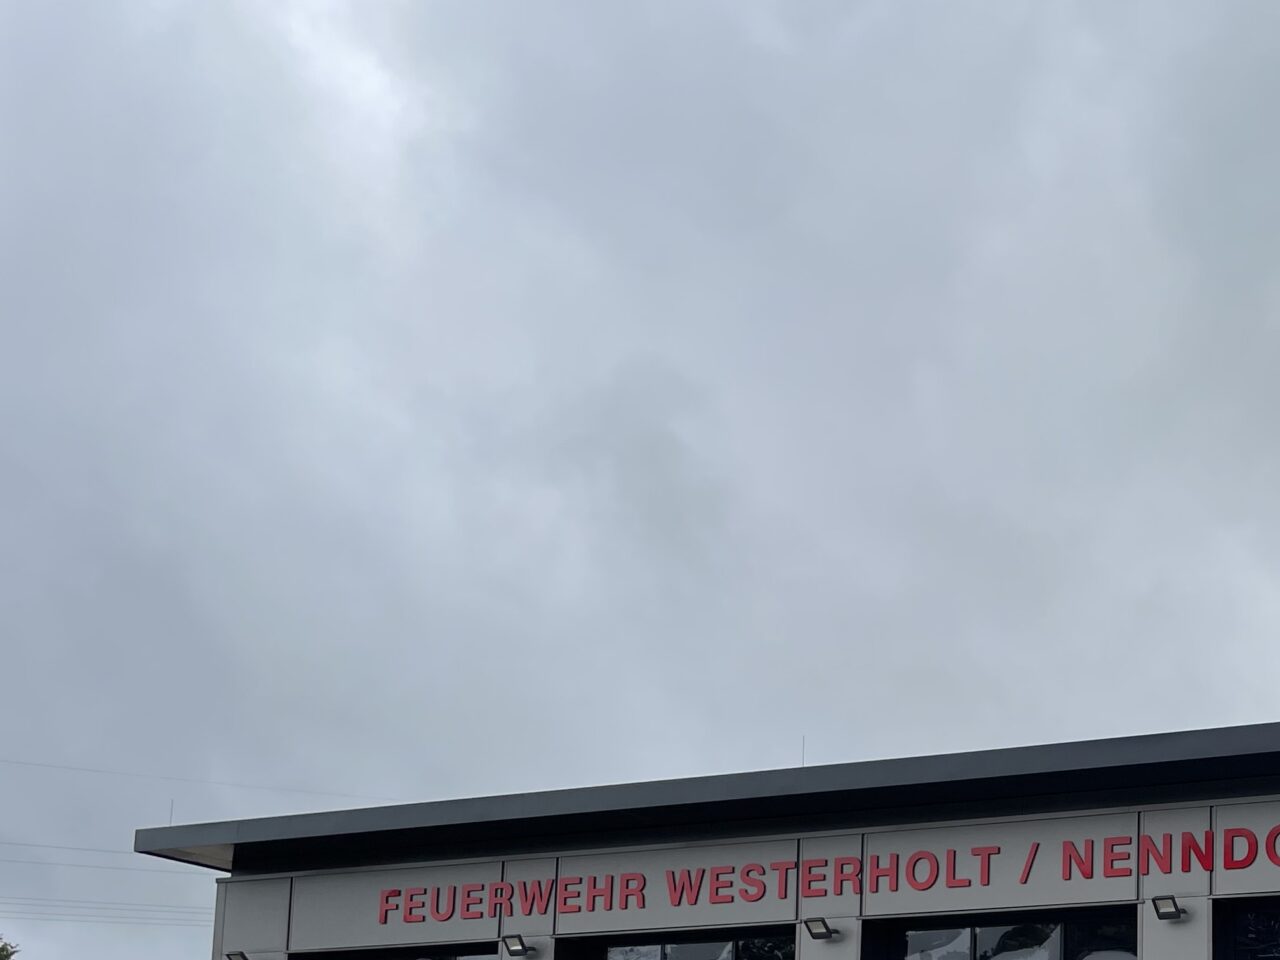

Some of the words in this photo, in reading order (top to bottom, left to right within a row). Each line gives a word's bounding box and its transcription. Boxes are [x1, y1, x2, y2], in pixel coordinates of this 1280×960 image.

[379, 873, 647, 925] FEUERWEHR
[667, 846, 1000, 908] WESTERHOLT
[1020, 842, 1040, 885] /
